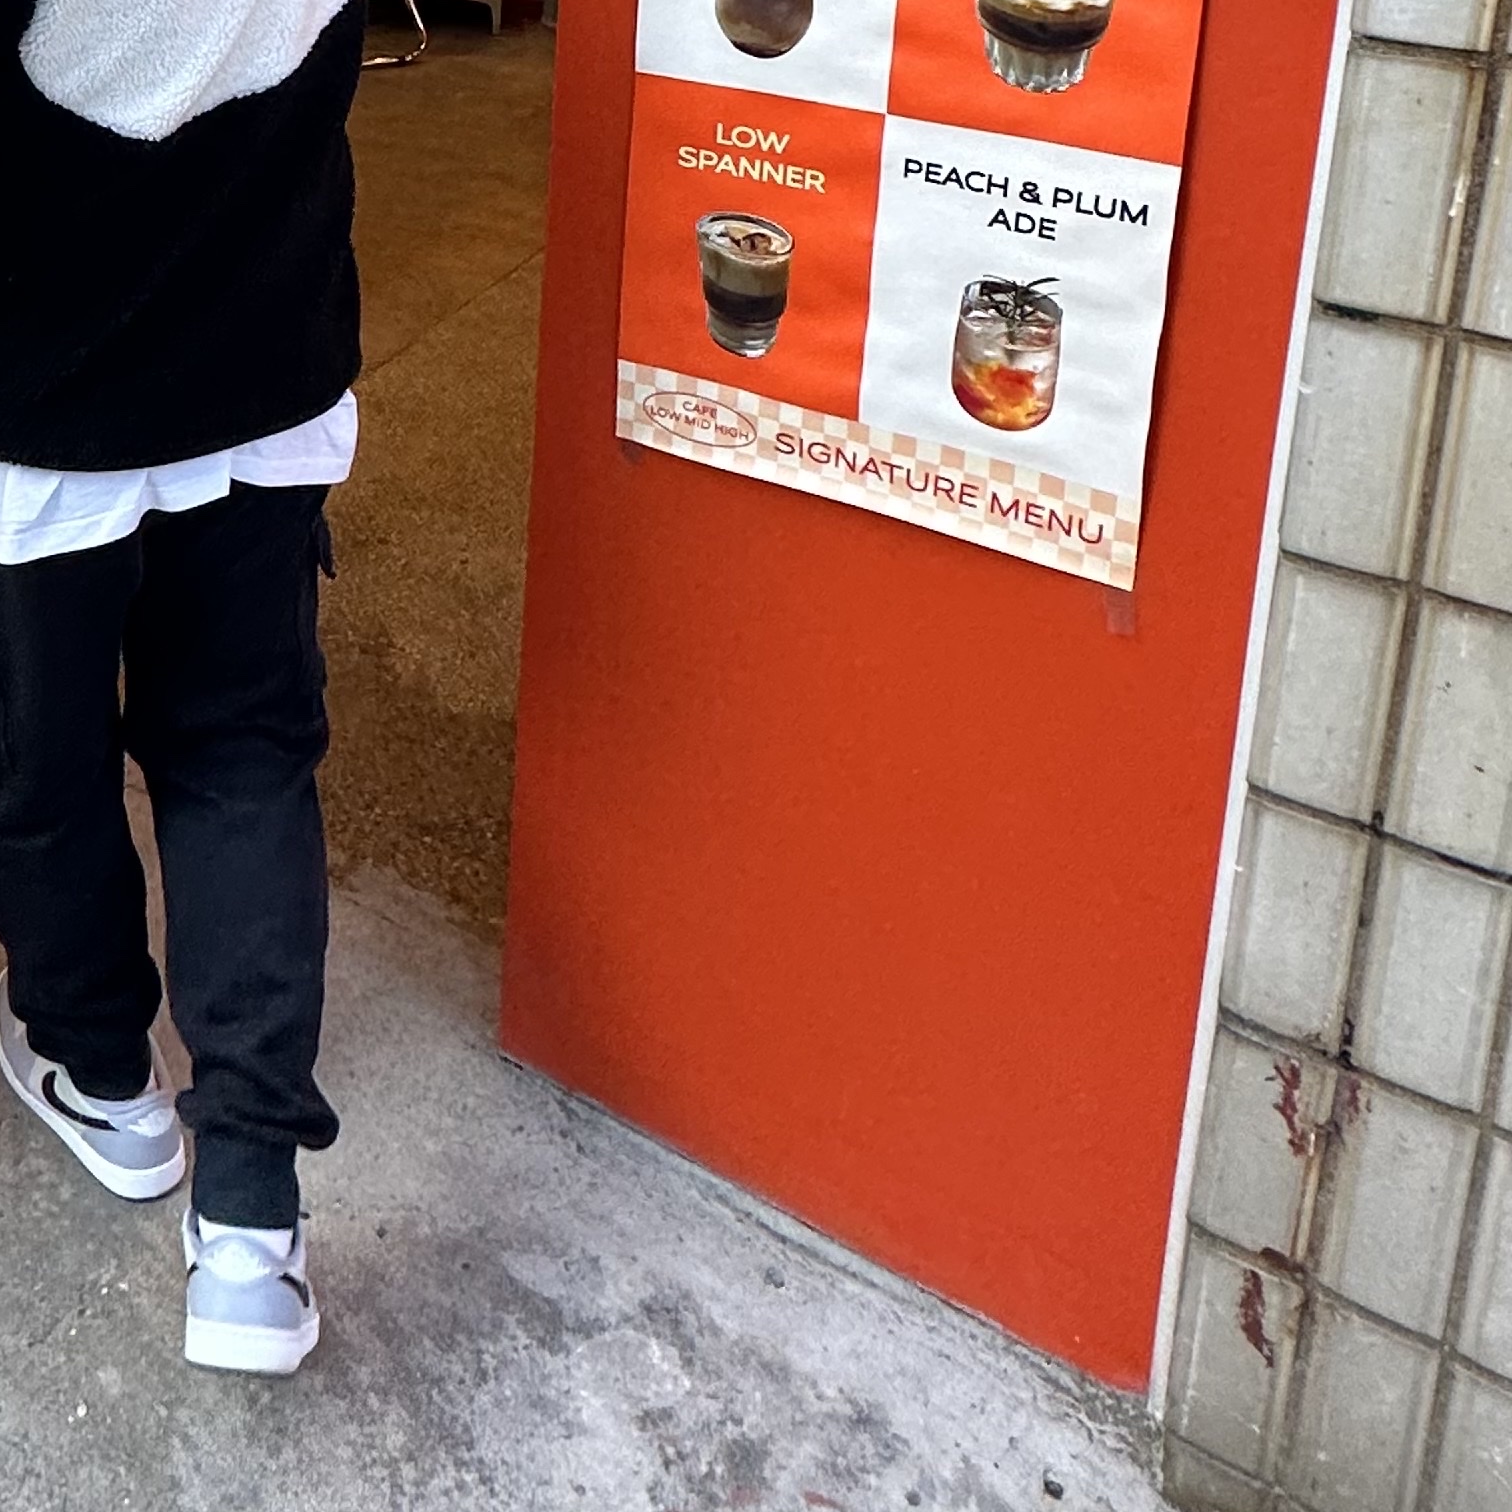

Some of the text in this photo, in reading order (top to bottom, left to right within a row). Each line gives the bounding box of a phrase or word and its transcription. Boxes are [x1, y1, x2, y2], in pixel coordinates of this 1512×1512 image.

[716, 122, 790, 155] LOW
[677, 146, 826, 194] SPANNER
[904, 158, 1149, 226] PEACH & PLUM
[987, 209, 1058, 241] ADE
[650, 405, 749, 441] LOW MID HIGH
[774, 432, 1104, 544] SIGNATURE MENU
